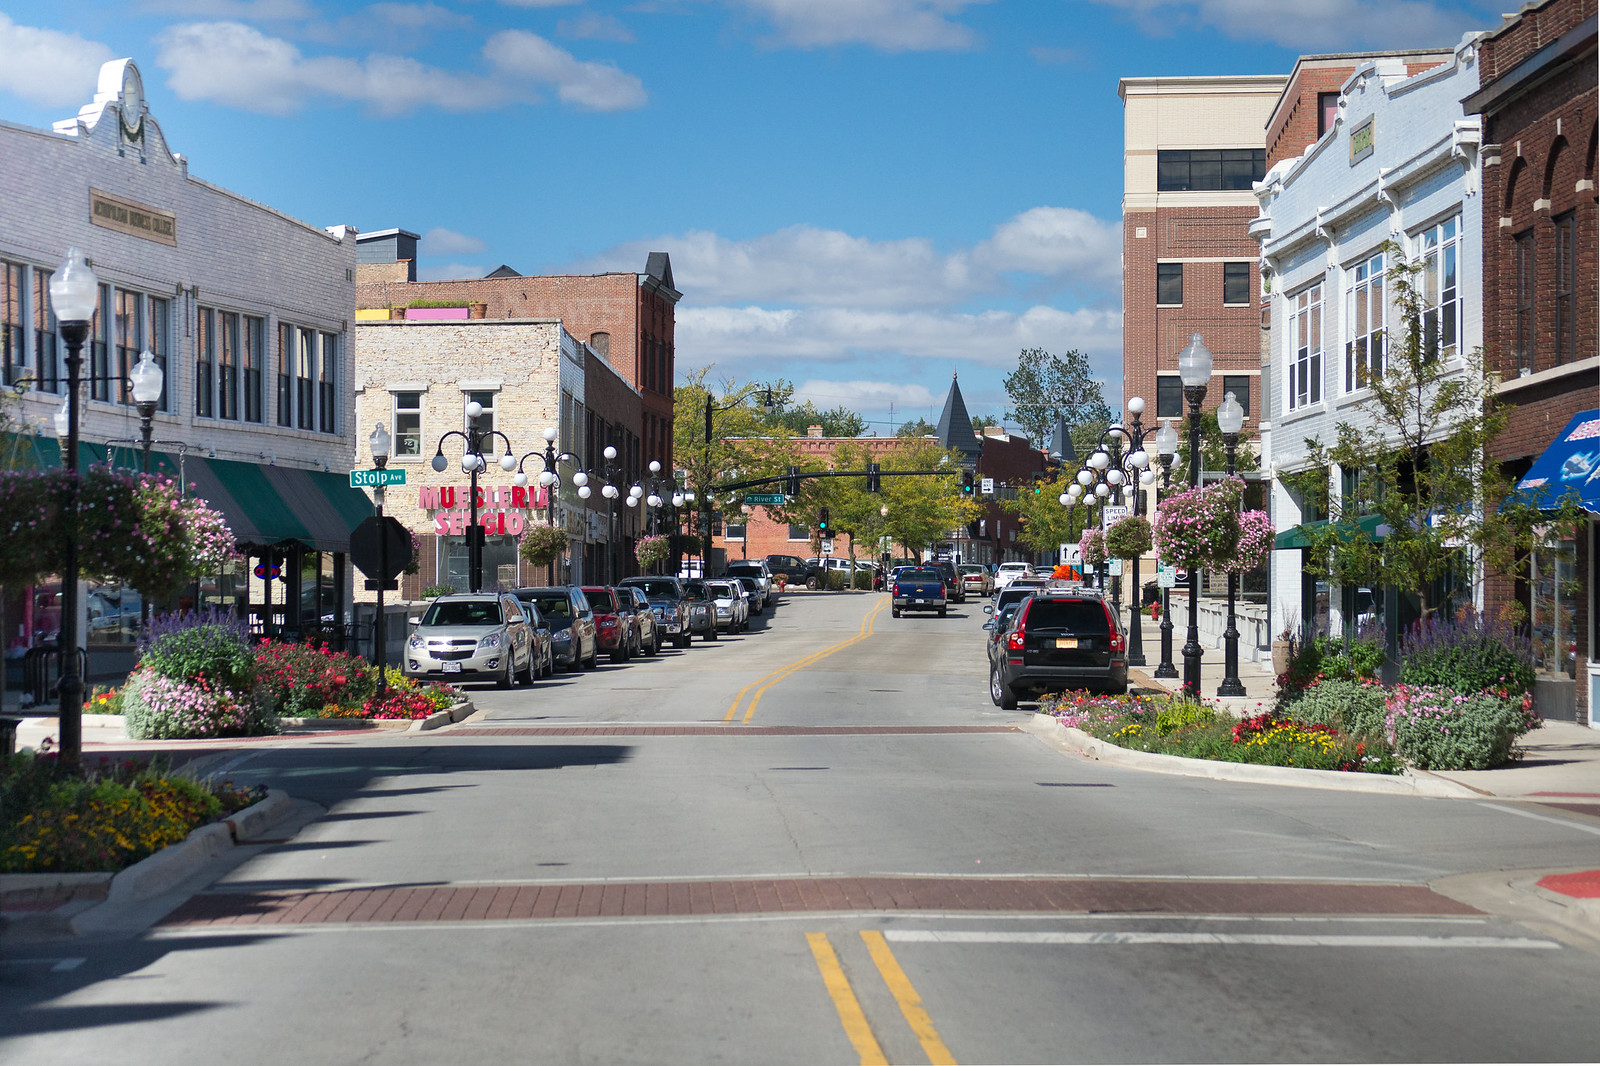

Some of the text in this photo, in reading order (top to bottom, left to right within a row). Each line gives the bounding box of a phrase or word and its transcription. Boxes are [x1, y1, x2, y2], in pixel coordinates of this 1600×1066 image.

[355, 471, 402, 484] Stolp Ave
[254, 567, 280, 576] OPN
